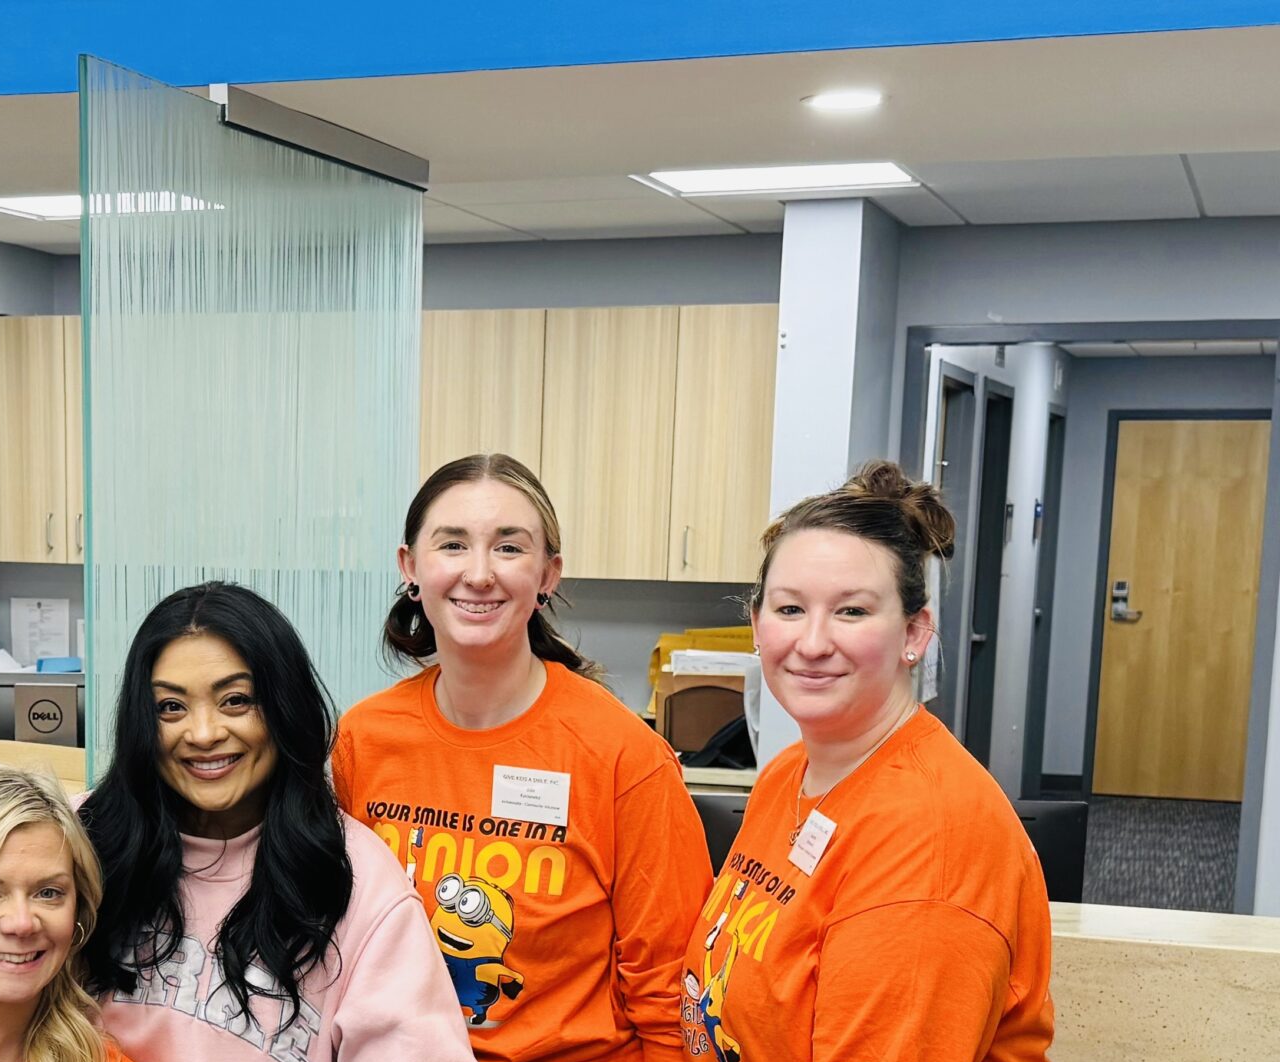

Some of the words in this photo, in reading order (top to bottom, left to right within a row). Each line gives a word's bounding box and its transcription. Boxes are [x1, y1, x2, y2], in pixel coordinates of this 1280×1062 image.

[32, 712, 59, 721] DELL
[366, 801, 410, 823] YOUR
[412, 806, 460, 830] SMILE
[462, 814, 475, 832] IS
[478, 818, 522, 838] ONE
[524, 823, 547, 840] IN
[551, 826, 567, 843] A
